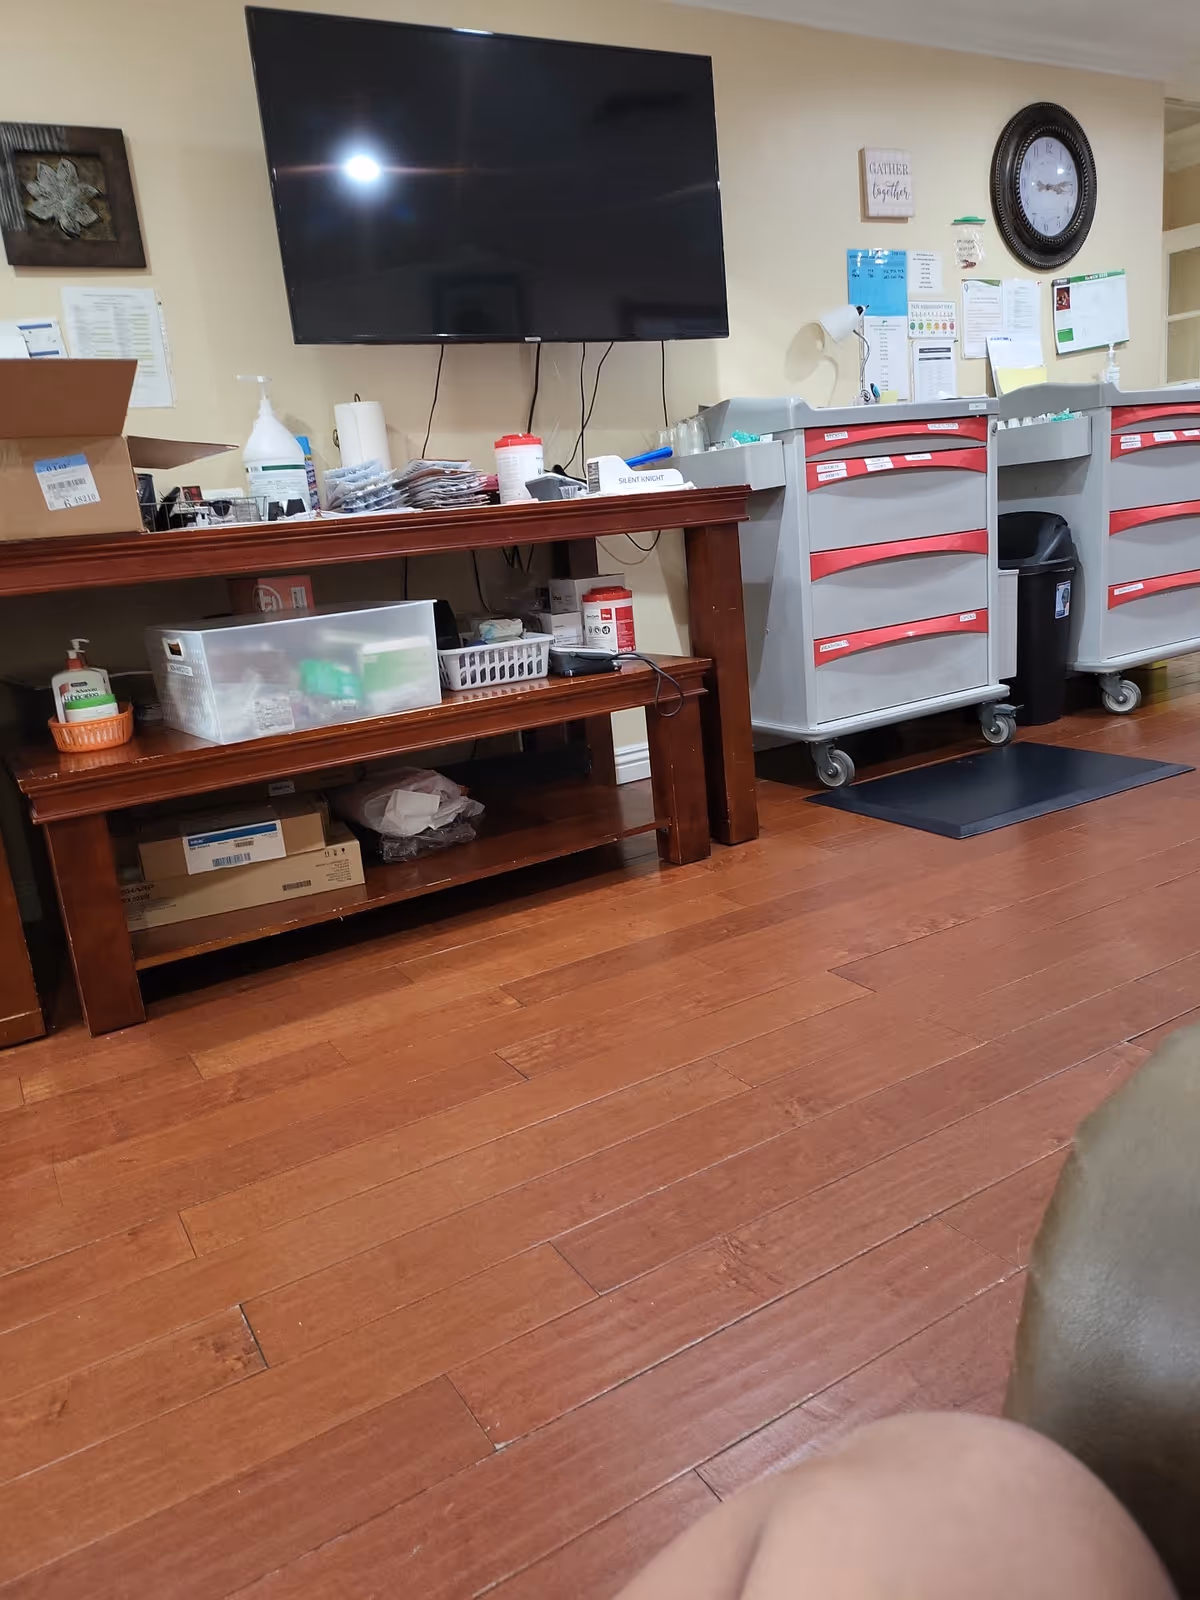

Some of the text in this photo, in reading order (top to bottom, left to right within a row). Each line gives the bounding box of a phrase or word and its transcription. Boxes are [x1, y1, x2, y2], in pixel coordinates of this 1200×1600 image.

[869, 161, 909, 176] GATHER
[872, 180, 911, 203] together
[618, 474, 664, 485] SILENT KNIGHT
